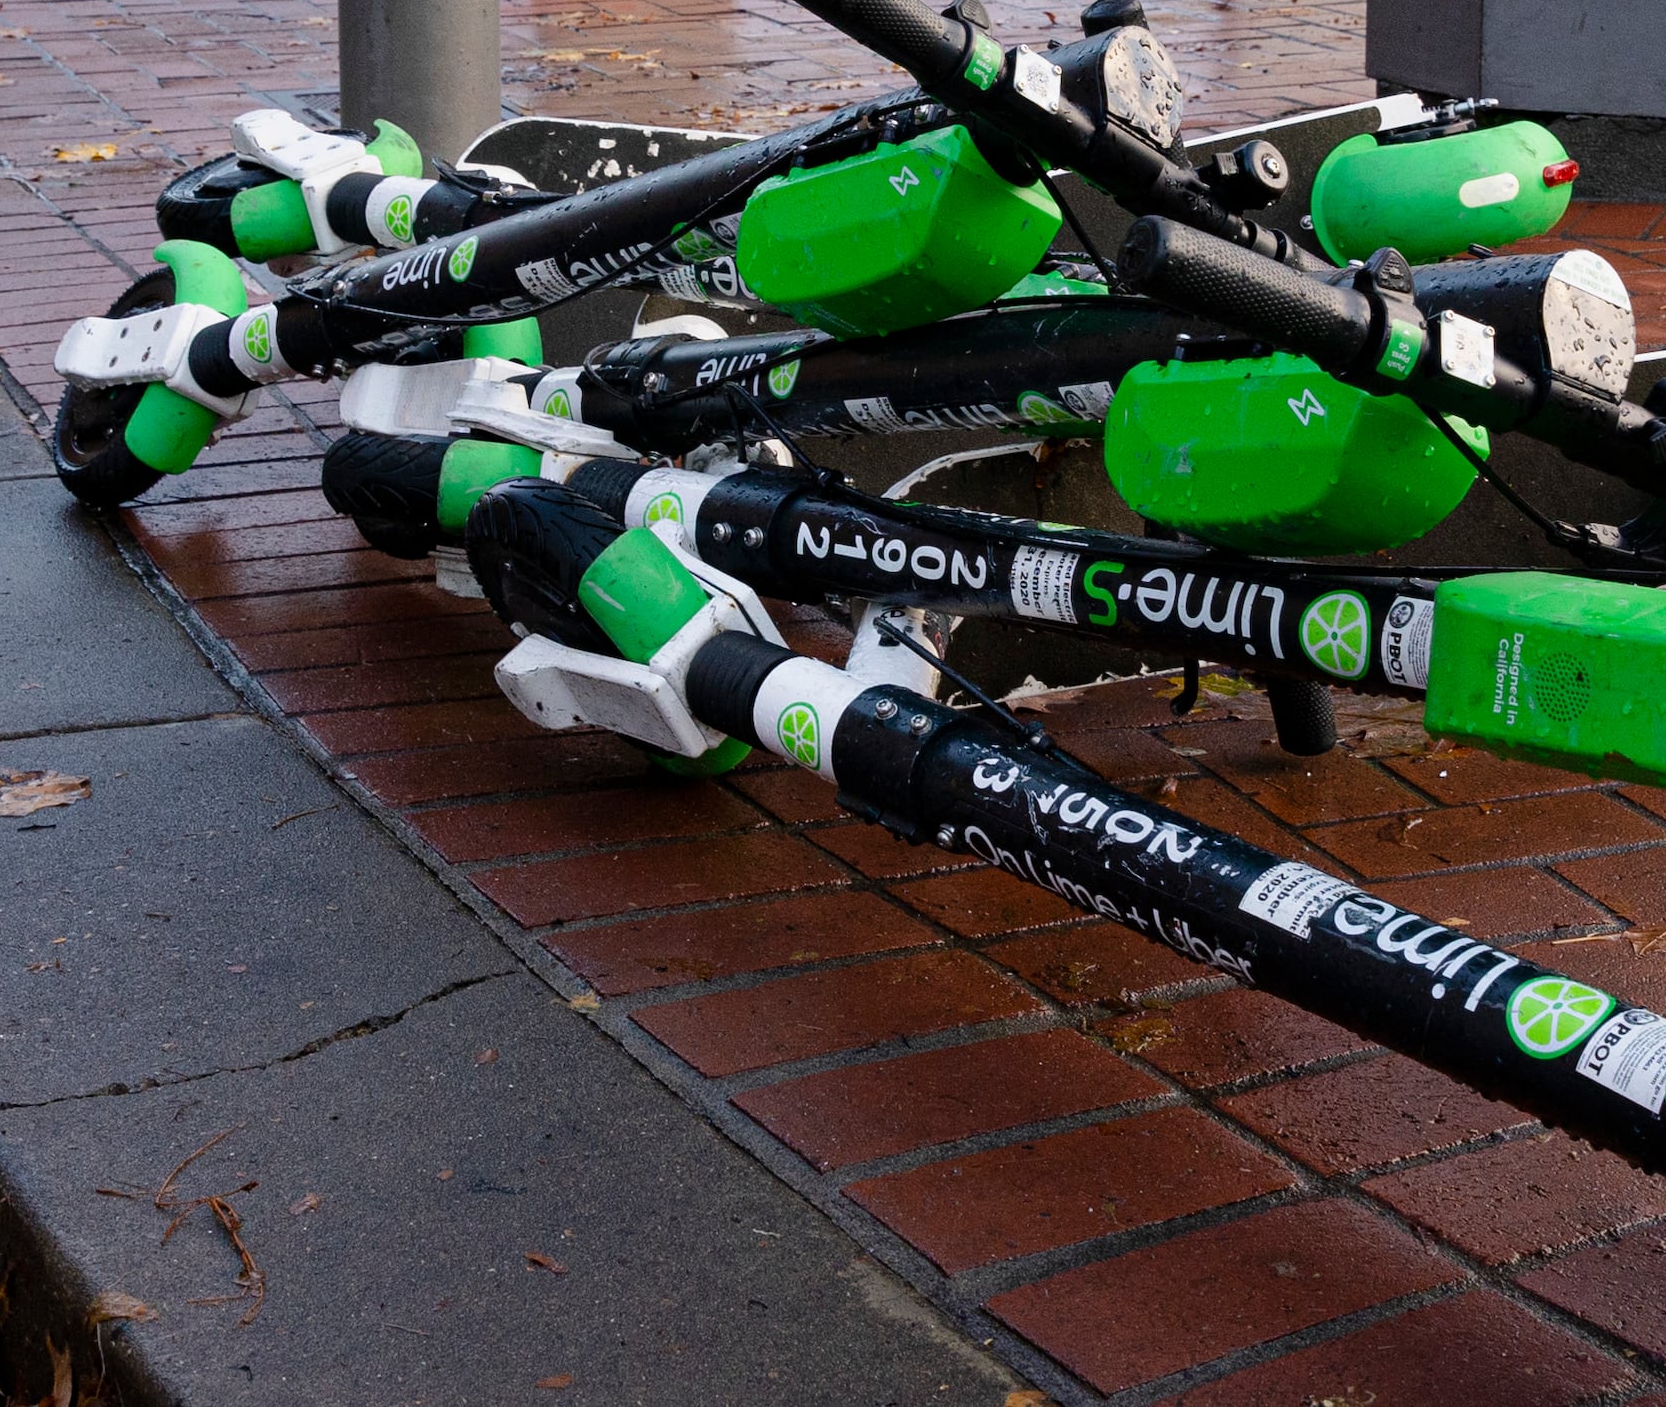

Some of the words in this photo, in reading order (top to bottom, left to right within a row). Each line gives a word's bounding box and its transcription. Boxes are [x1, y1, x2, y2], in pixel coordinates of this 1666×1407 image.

[383, 246, 447, 291] Lime
[795, 520, 989, 591] 20912
[1032, 550, 1046, 615] ecember
[1019, 571, 1029, 605] 2020
[1389, 631, 1408, 684] PBOT
[1493, 639, 1509, 713] California
[1509, 633, 1524, 706] Designed
[964, 825, 1028, 880] On
[1024, 849, 1124, 923] Lime
[1126, 905, 1149, 930] +
[1151, 907, 1257, 984] Uber
[1257, 871, 1288, 902] 2020
[1267, 872, 1317, 917] cember
[1334, 896, 1520, 1013] Lime
[1588, 1022, 1632, 1076] PBOT
